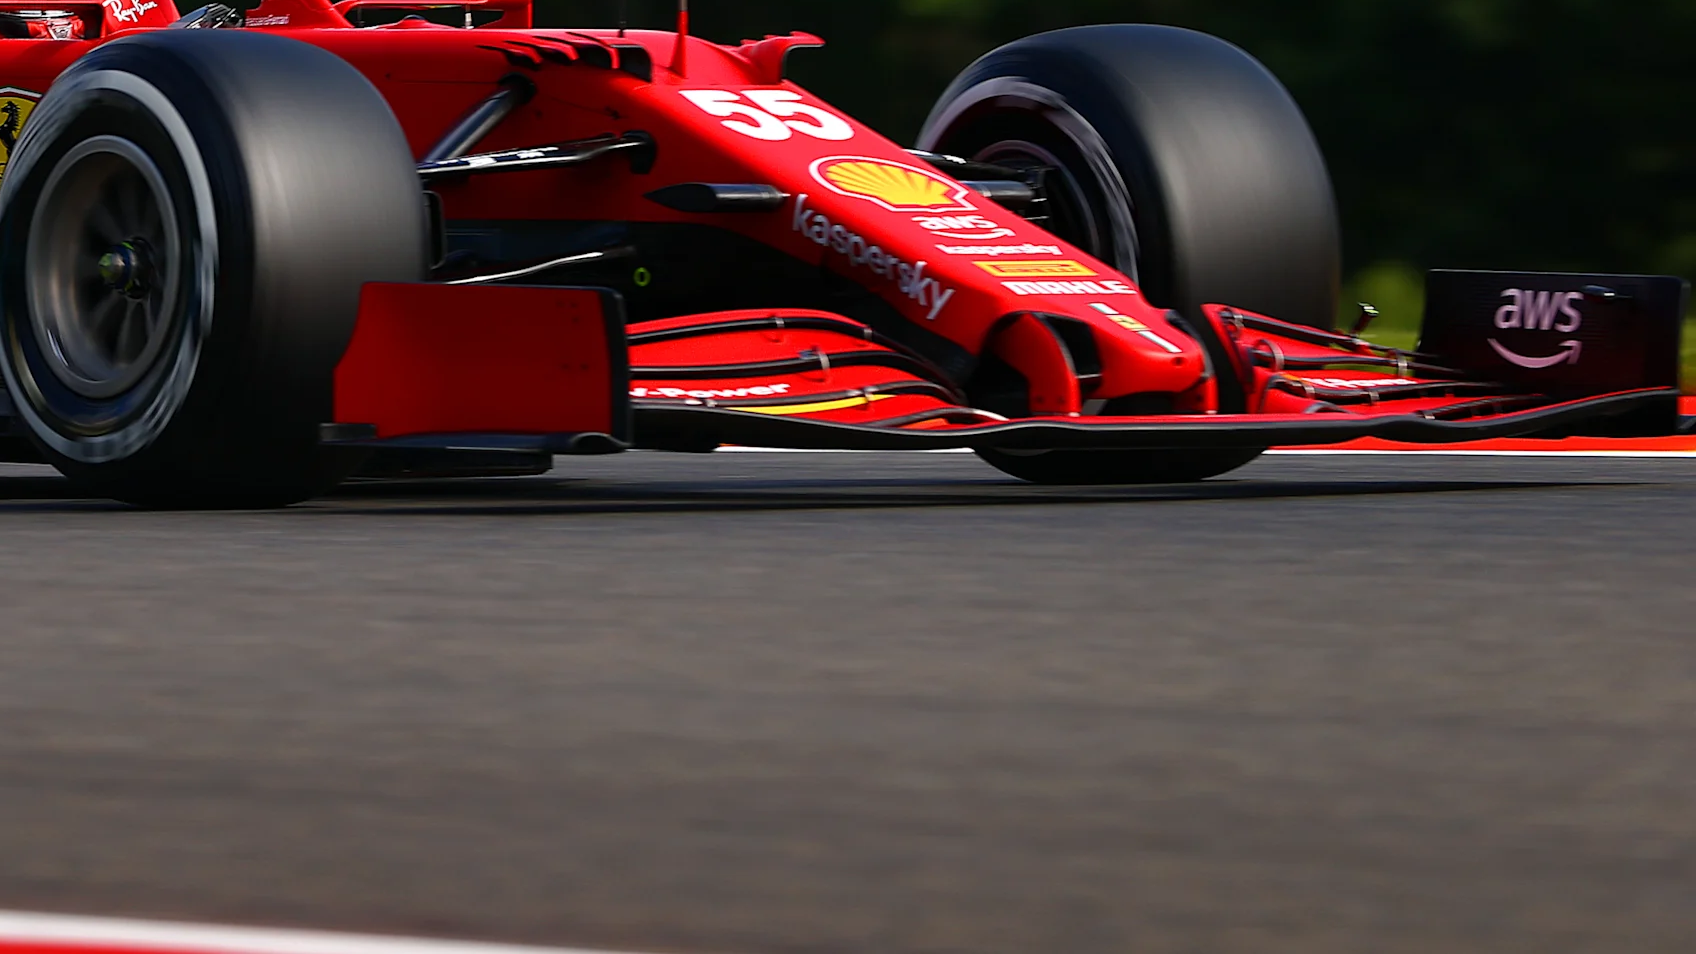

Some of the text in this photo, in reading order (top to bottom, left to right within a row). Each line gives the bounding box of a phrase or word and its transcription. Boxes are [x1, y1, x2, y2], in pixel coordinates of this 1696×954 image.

[678, 89, 855, 141] 55
[911, 215, 999, 229] aws
[792, 193, 956, 320] kaspersky
[1000, 280, 1138, 295] MAHLE
[1494, 288, 1584, 333] aws
